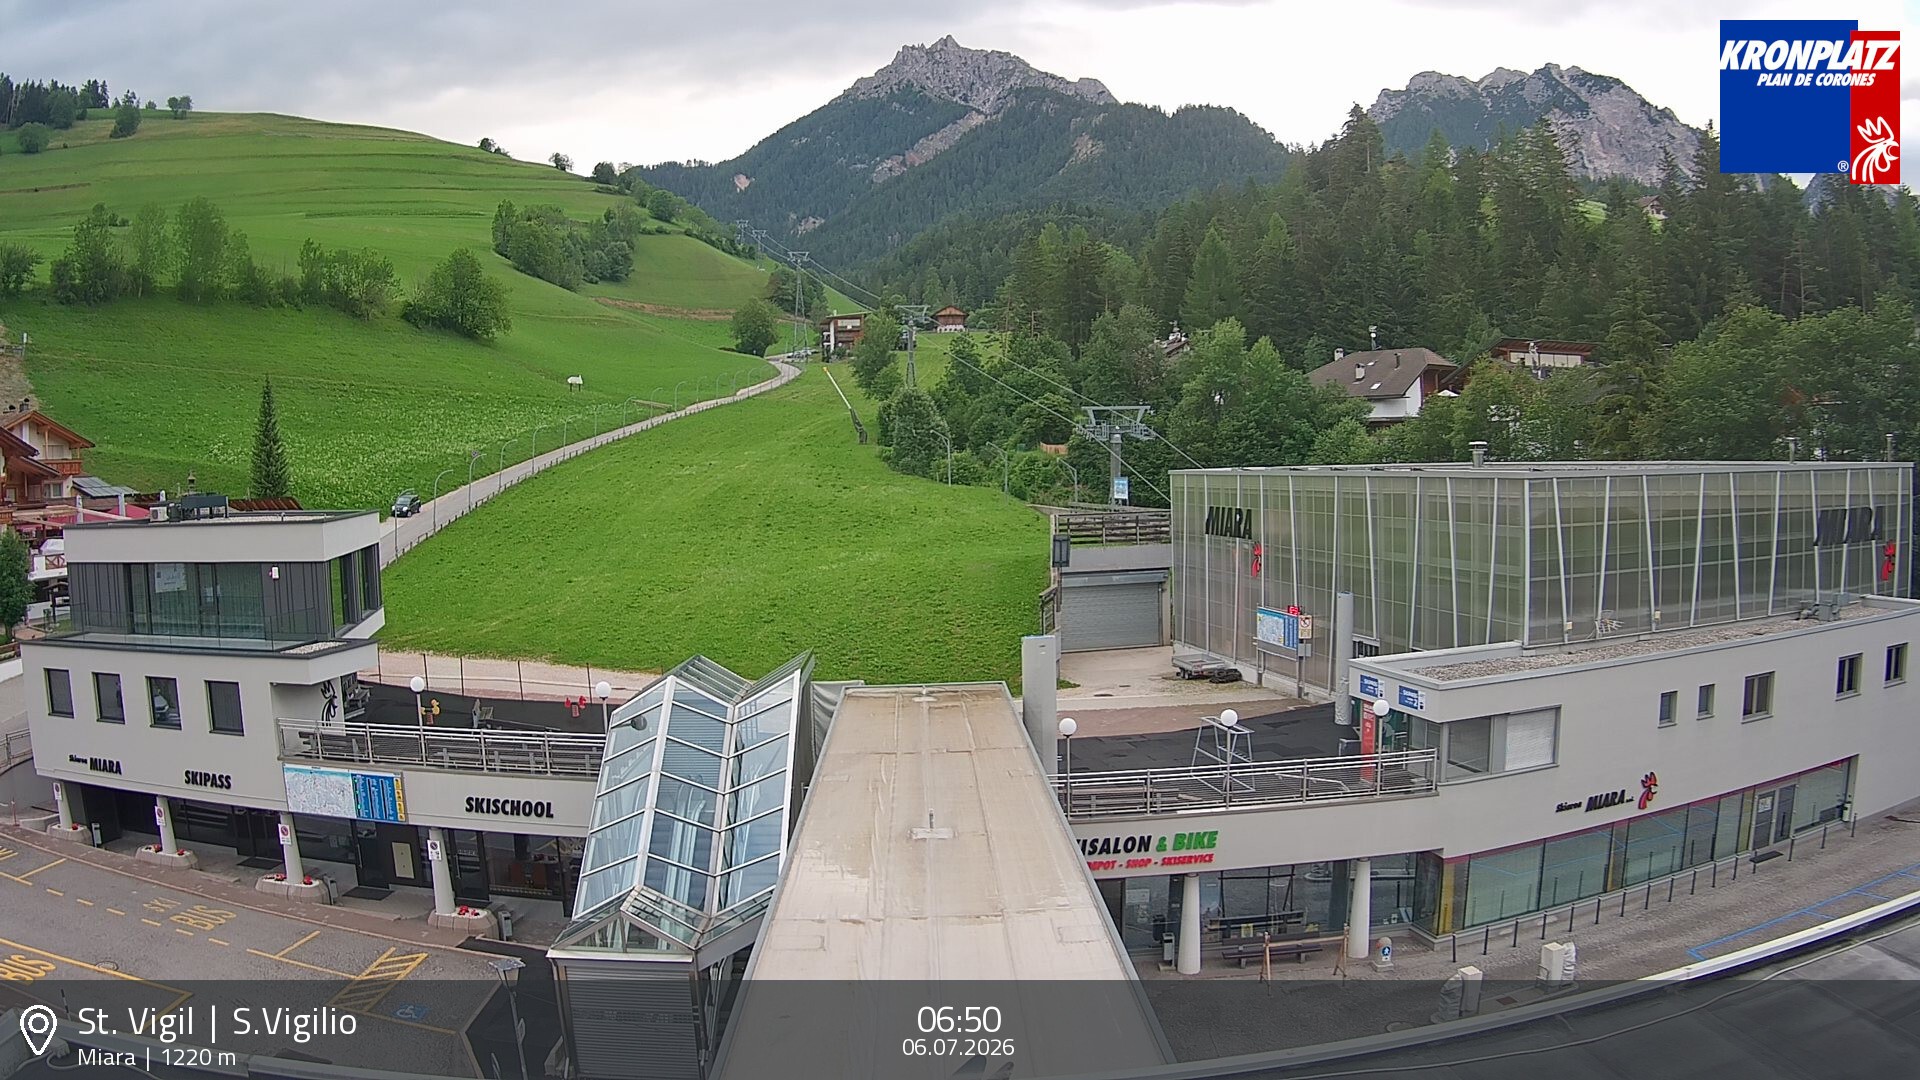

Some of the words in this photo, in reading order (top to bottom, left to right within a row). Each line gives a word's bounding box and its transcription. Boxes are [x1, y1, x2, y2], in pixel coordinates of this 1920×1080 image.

[1204, 506, 1253, 540] MIARA
[1813, 505, 1884, 546] MIARA
[89, 757, 122, 775] MIARA
[184, 770, 232, 789] SKIPASS
[465, 796, 554, 818] SKISCHOOL
[1585, 789, 1626, 813] MIARA
[1156, 836, 1168, 852] &
[1172, 830, 1218, 851] BIKE
[1126, 858, 1152, 869] SHOP
[1161, 853, 1214, 866] SKISERVICE
[169, 905, 237, 931] BUS
[0, 954, 56, 985] BUS
